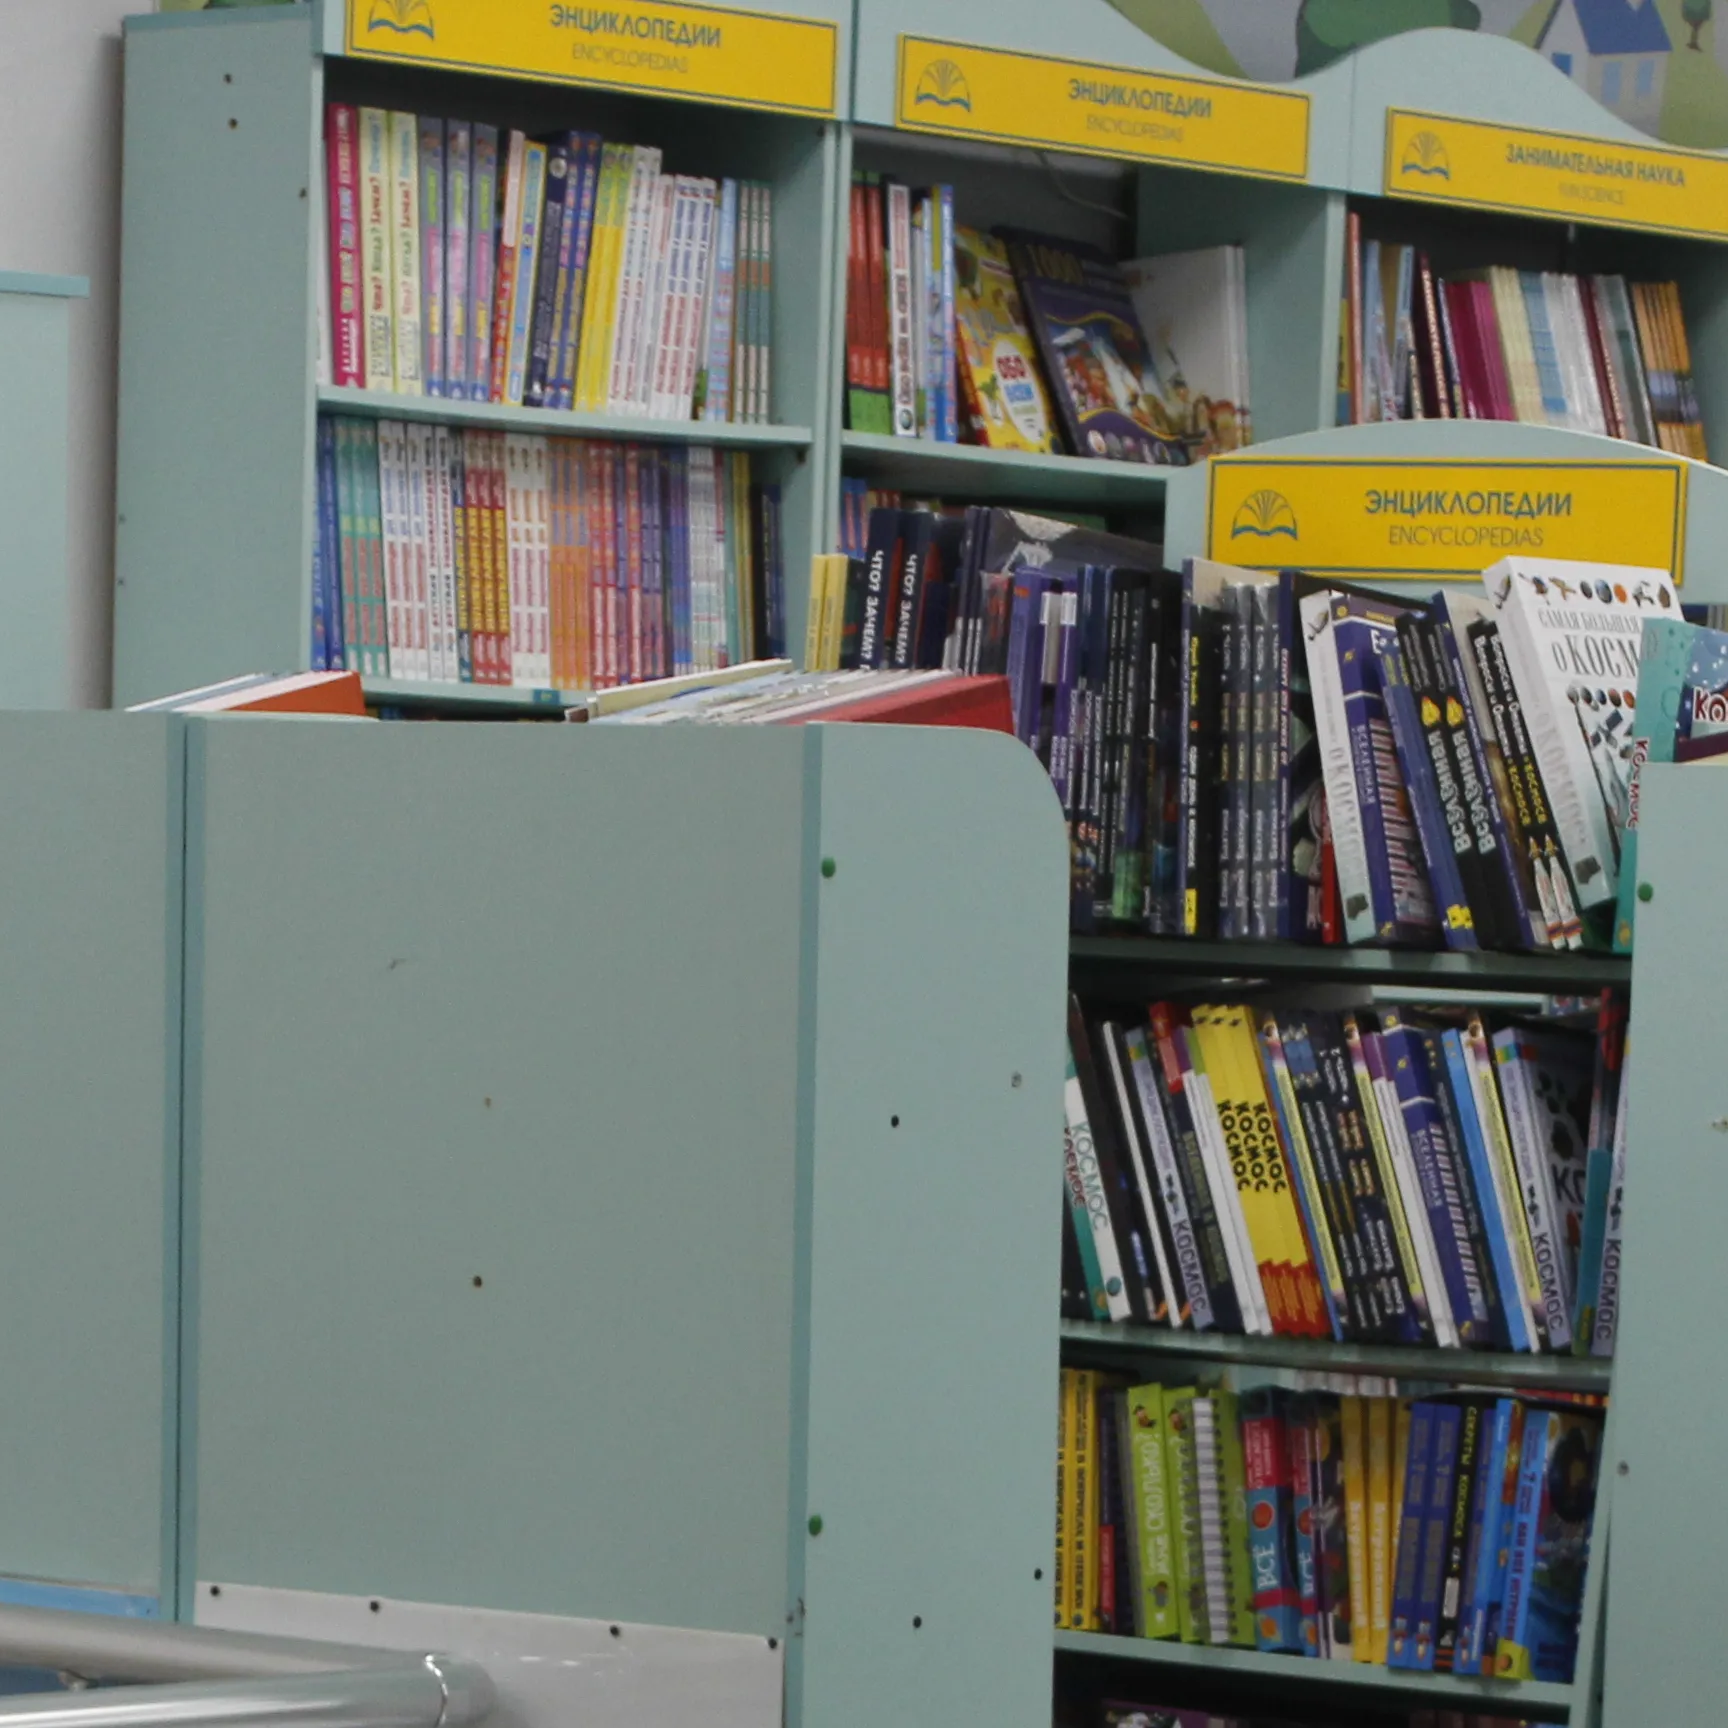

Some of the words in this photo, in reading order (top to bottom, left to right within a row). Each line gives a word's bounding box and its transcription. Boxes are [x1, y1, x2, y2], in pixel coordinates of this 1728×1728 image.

[549, 3, 722, 49] ЭНЦИКЛОПЕДИИ
[1067, 79, 1213, 119] ЭНЦИКЛОПЕДИИ
[1505, 143, 1634, 178] ЗАНИМАТЕЛЬНАЯ
[1636, 163, 1686, 187] НАУКА
[1364, 488, 1572, 519] ЭНЦИКЛОПЕДИИ
[1388, 525, 1544, 548] ENCYCLOPEDIAS
[1564, 633, 1640, 678] КОСМ
[1532, 1231, 1565, 1332] КОСМОС
